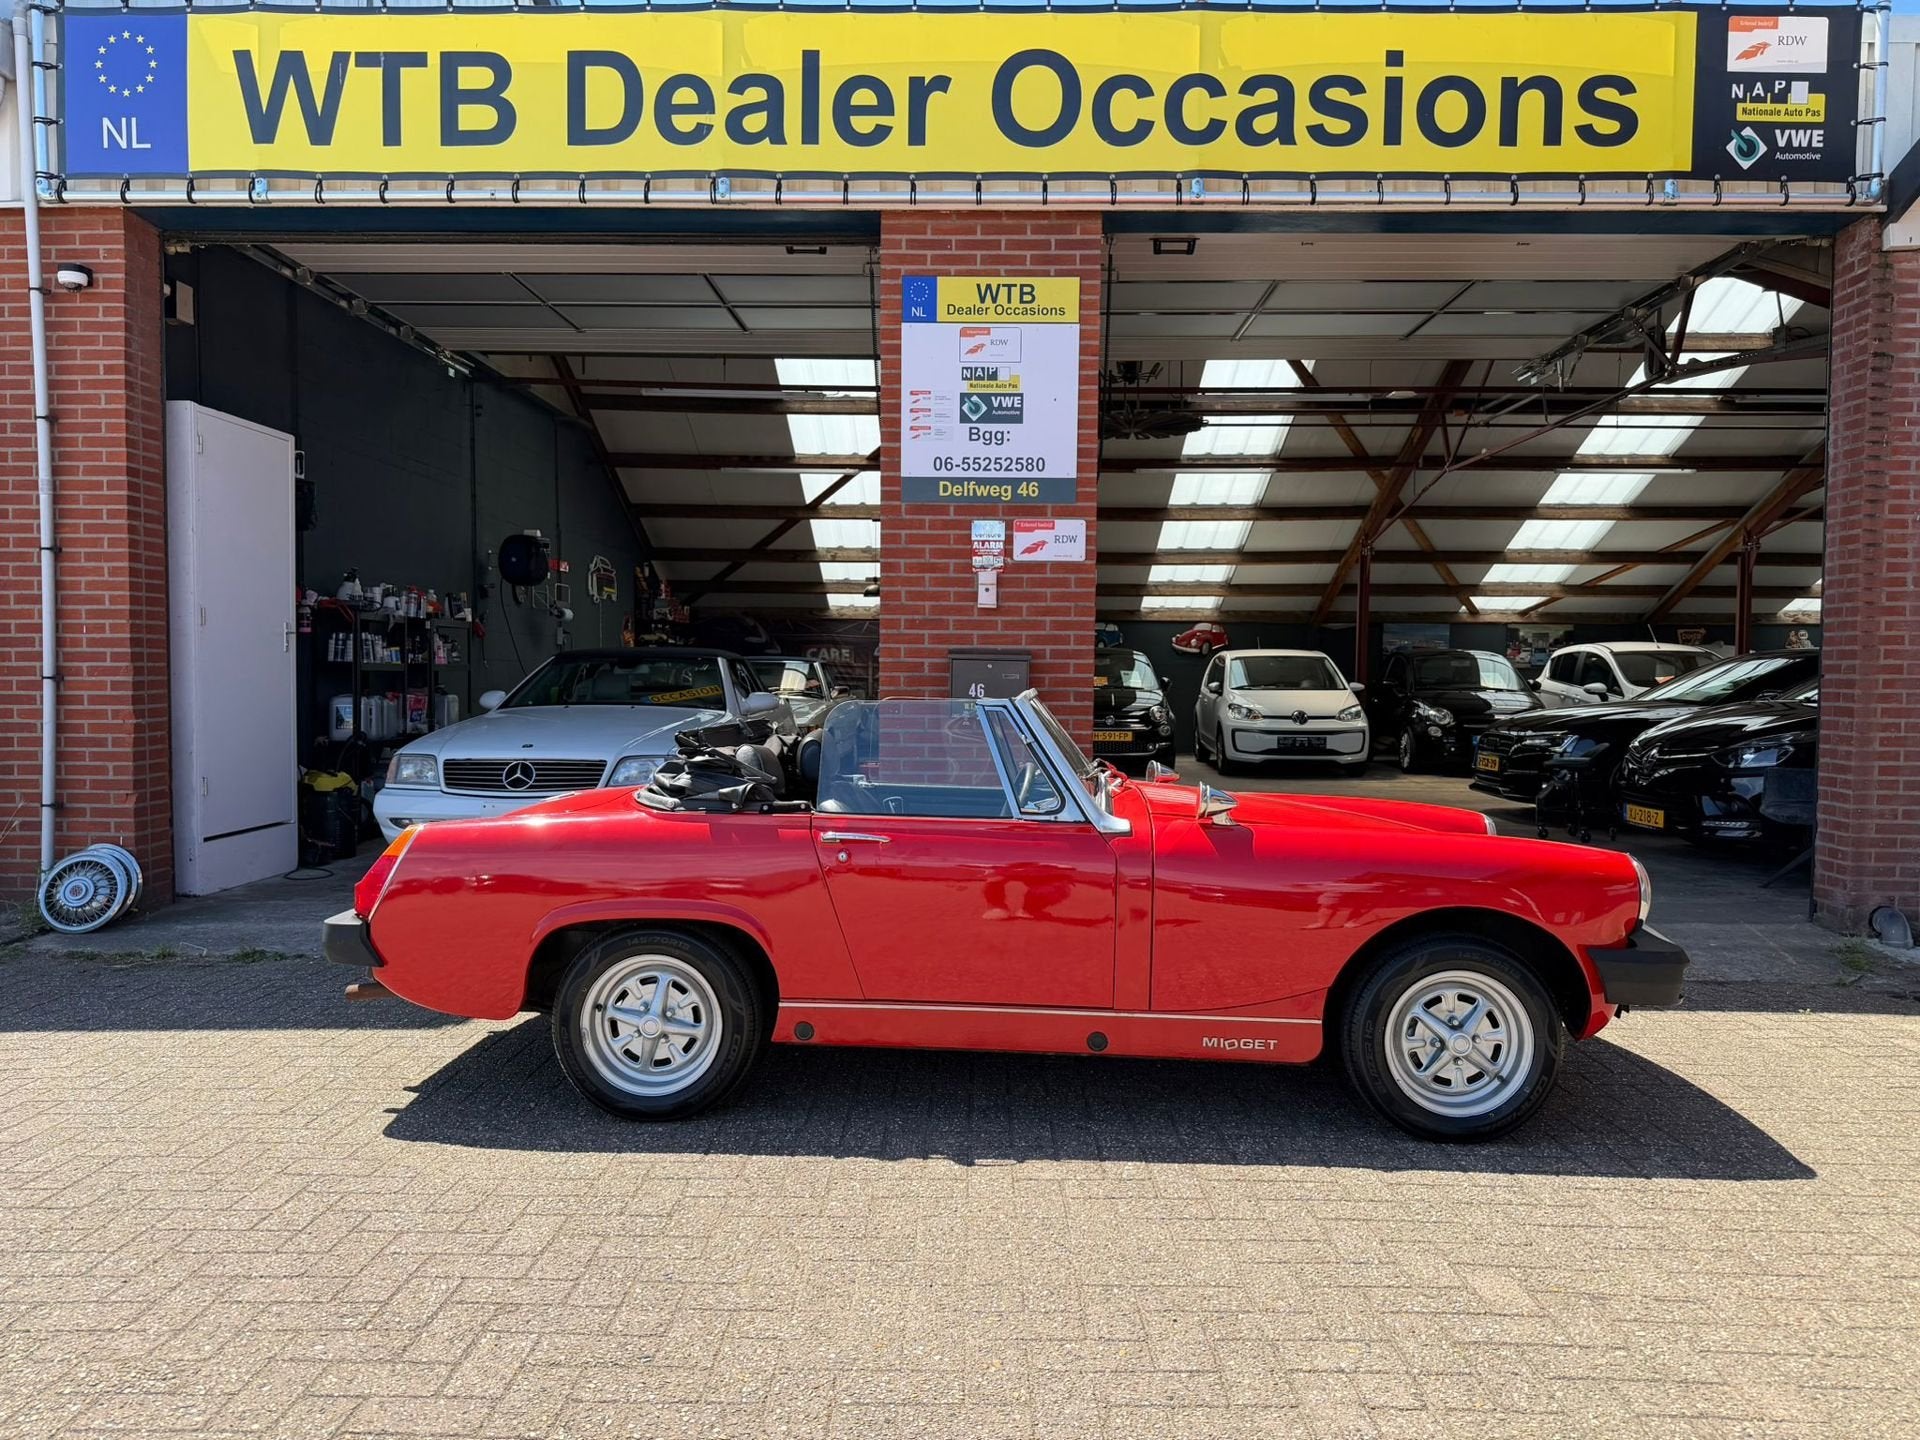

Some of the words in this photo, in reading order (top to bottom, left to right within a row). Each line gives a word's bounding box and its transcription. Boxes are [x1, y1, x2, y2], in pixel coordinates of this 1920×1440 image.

[1777, 35, 1808, 46] RDW
[233, 50, 517, 146] WTB
[567, 50, 952, 147] Dealer
[992, 49, 1639, 148] Occasions
[1742, 107, 1781, 117] Nationale
[1784, 108, 1803, 117] Auto
[1806, 108, 1821, 117] Pas
[102, 117, 151, 149] NL
[1775, 129, 1824, 147] VWE
[1775, 152, 1821, 160] Automotive
[976, 283, 1037, 305] WTB
[911, 307, 927, 317] NL
[947, 304, 990, 316] Dealer
[994, 305, 1066, 316] Occasions
[991, 396, 1022, 408] VWE
[968, 426, 1011, 446] Bgg:
[933, 456, 1046, 472] 06-55252580
[939, 481, 1012, 501] Delfweg
[1017, 482, 1039, 497] 46
[972, 541, 1004, 549] ALARM
[1054, 535, 1078, 544] RDW
[650, 686, 721, 703] OCCASION
[968, 683, 985, 698] 46
[1202, 1037, 1278, 1050] MIDGET
